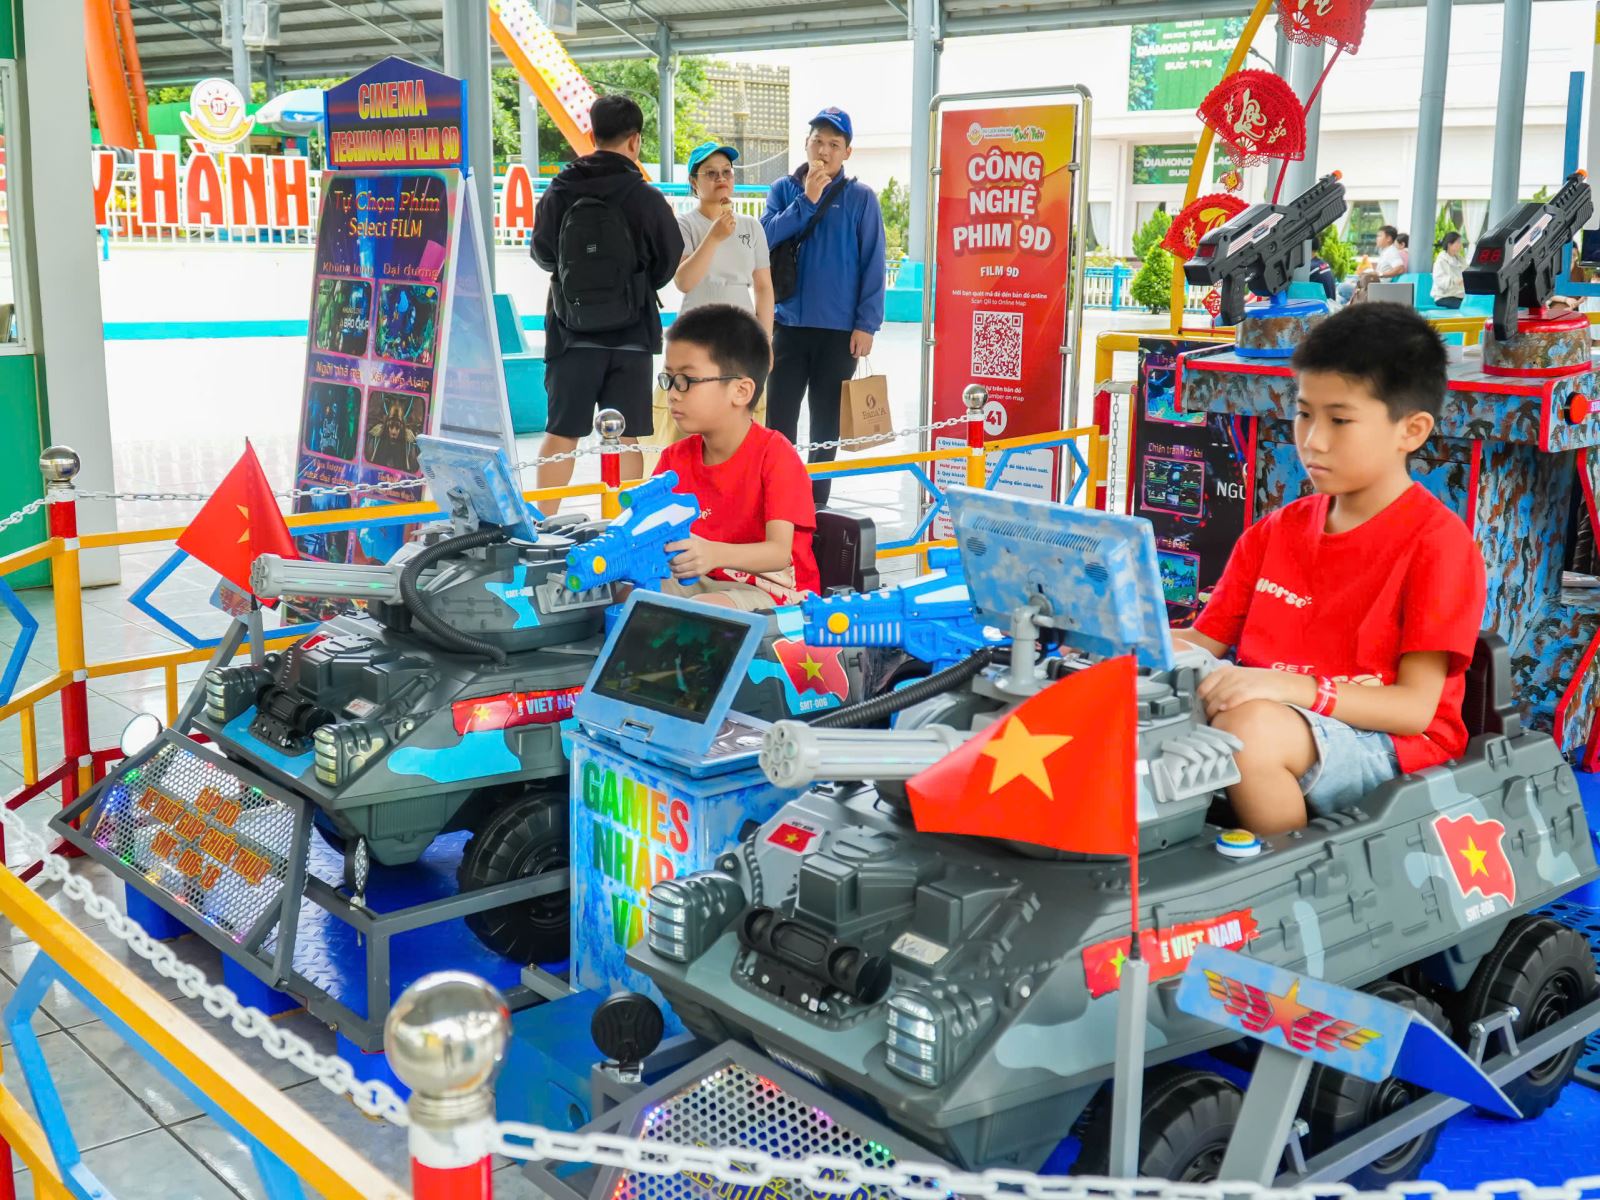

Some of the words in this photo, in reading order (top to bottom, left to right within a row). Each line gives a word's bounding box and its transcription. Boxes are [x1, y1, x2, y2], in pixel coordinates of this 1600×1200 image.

[1136, 42, 1190, 57] DIAMOND
[1192, 37, 1240, 52] PALAC
[358, 79, 427, 120] CINEMA
[408, 127, 440, 160] FILM
[441, 126, 460, 160] 9D
[968, 149, 1042, 181] CÔNG
[1143, 157, 1193, 168] DIAMOND
[138, 142, 311, 227] HÀNH
[334, 190, 353, 213] Tự
[356, 190, 395, 214] Chọn
[969, 184, 1038, 220] NGHỆ
[349, 217, 387, 238] Select
[390, 218, 422, 238] FILM
[953, 223, 1012, 251] PHIM
[1019, 224, 1051, 251] 9D
[383, 262, 401, 277] Đại
[980, 265, 1003, 277] FILM
[1006, 266, 1020, 278] 9D
[986, 410, 1002, 426] 41
[1255, 577, 1308, 609] Horse
[1271, 661, 1316, 675] GET
[525, 696, 554, 716] VIET
[557, 692, 581, 712] NA
[582, 759, 690, 854] GAMES
[1207, 918, 1244, 948] NAM
